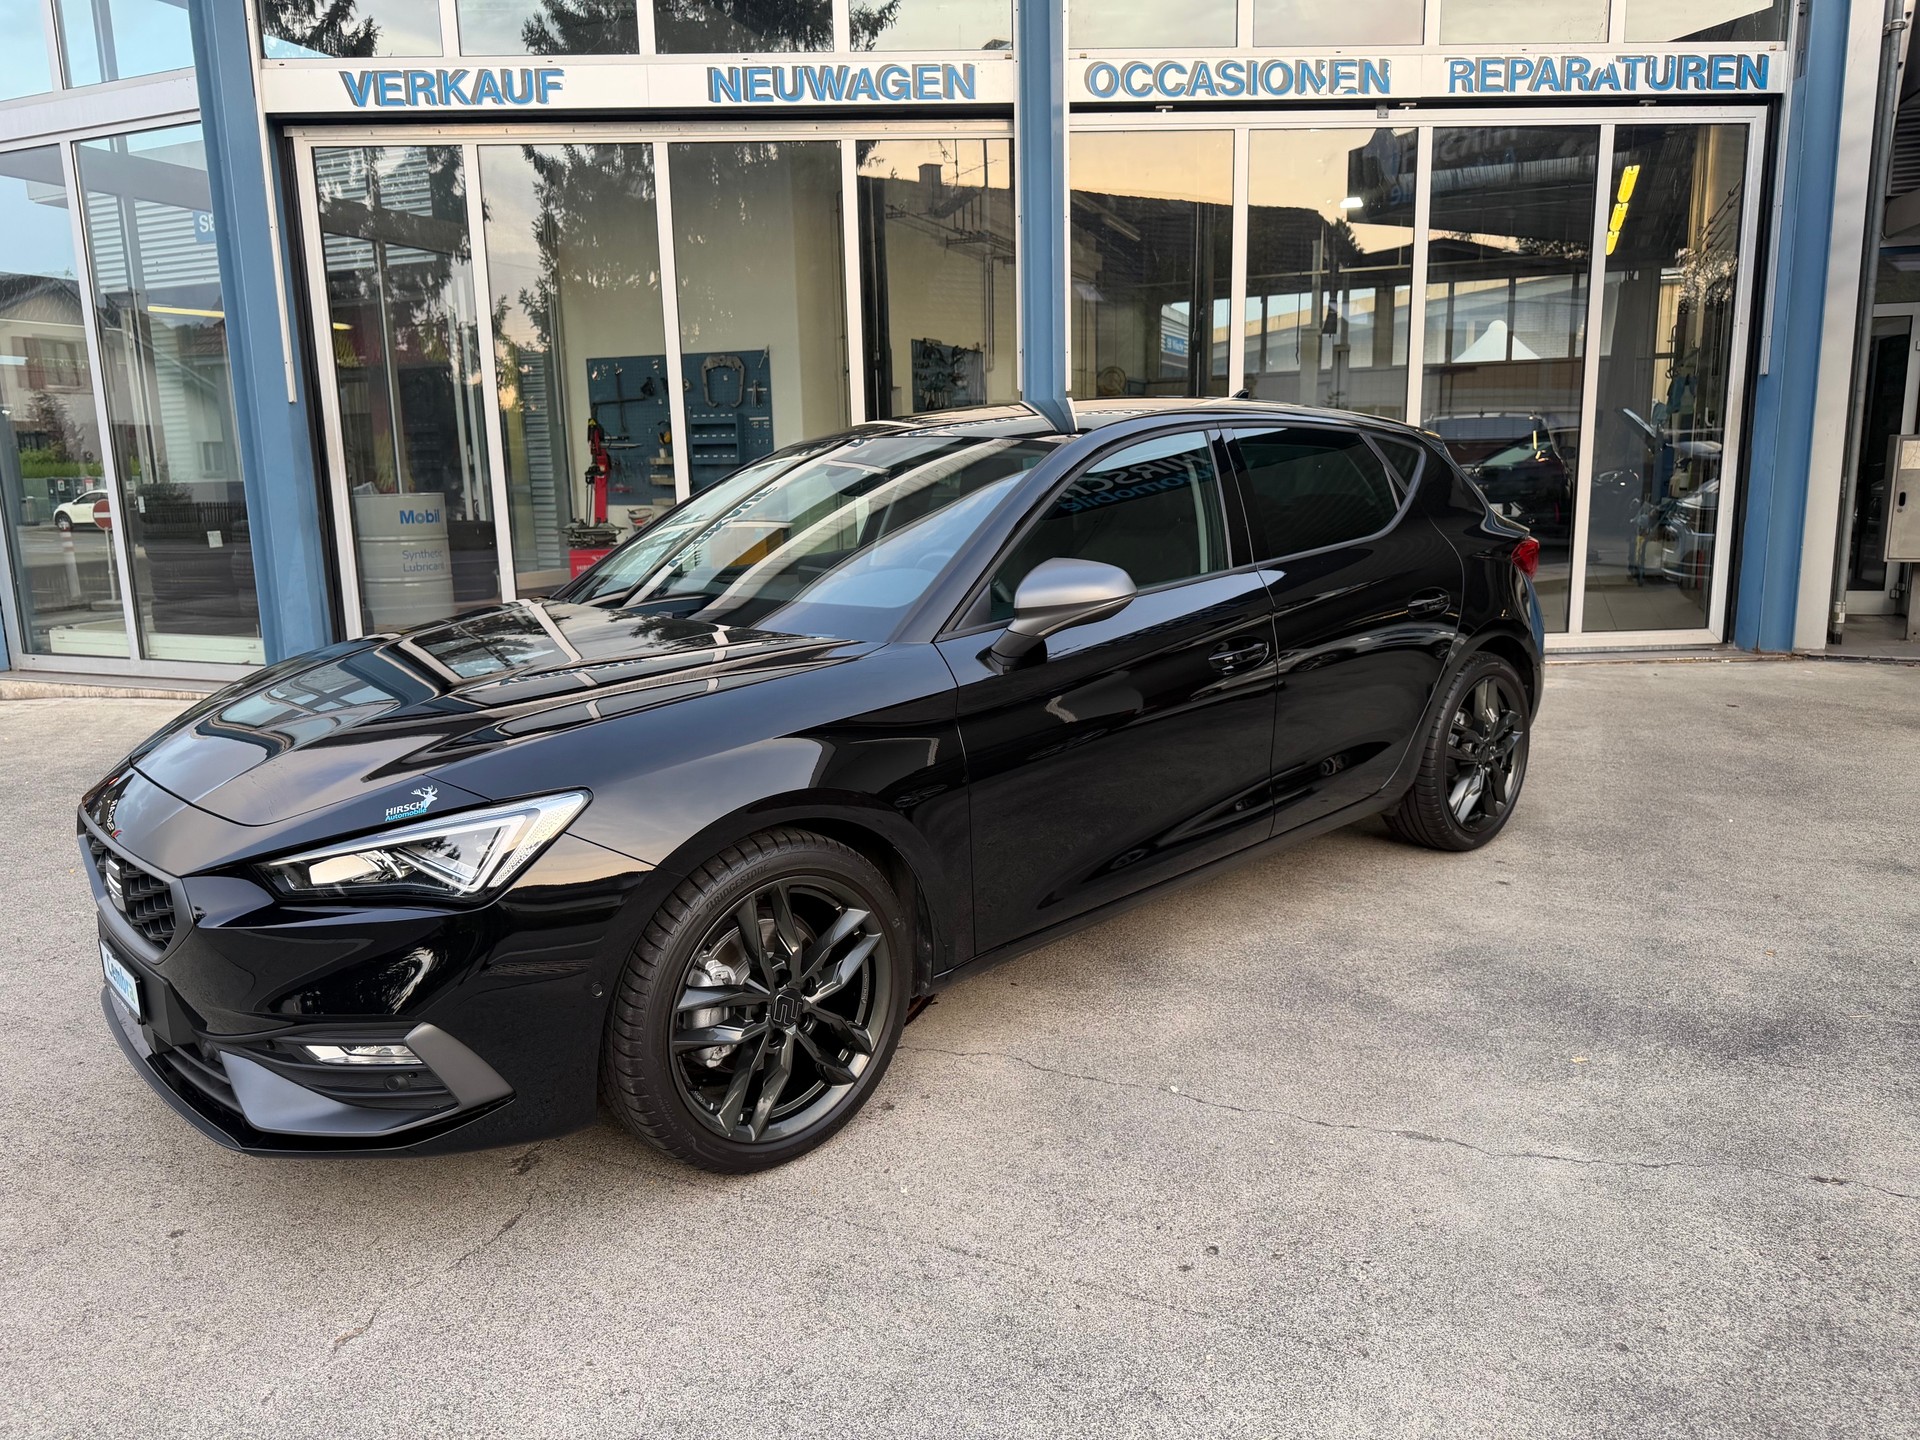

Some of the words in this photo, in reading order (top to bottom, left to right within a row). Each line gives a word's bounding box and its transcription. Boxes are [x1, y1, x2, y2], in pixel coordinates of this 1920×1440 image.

[1084, 59, 1391, 98] OCCASIONEN
[1444, 54, 1769, 93] REPARATUREN
[339, 68, 564, 107] VERKAUF
[707, 64, 976, 102] NEUWAGEN
[399, 509, 440, 524] Mobil
[385, 801, 423, 816] HIRSCH
[385, 808, 427, 822] Automobile
